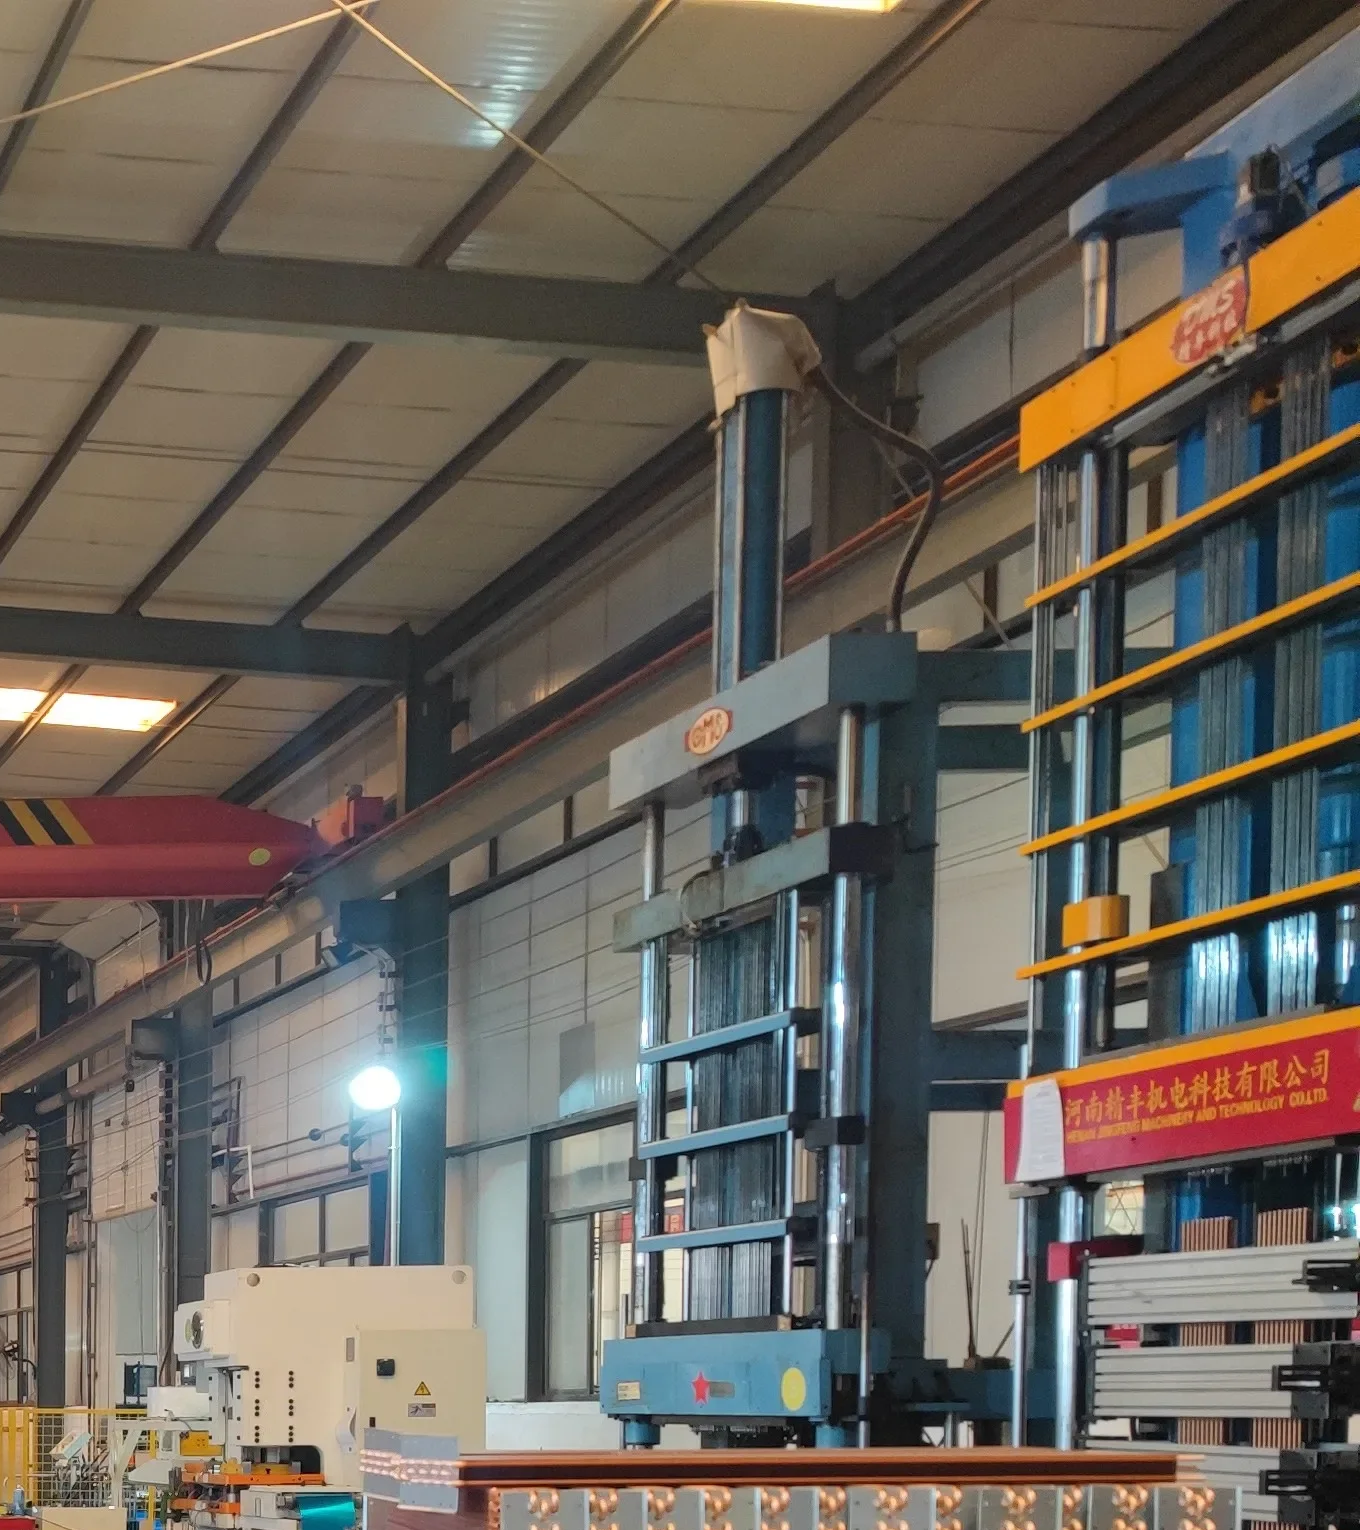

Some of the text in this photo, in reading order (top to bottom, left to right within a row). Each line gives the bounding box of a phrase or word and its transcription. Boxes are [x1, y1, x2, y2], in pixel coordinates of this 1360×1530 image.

[1065, 1049, 1330, 1128] 河南精丰机电科技有限公司
[1196, 1107, 1217, 1122] AND
